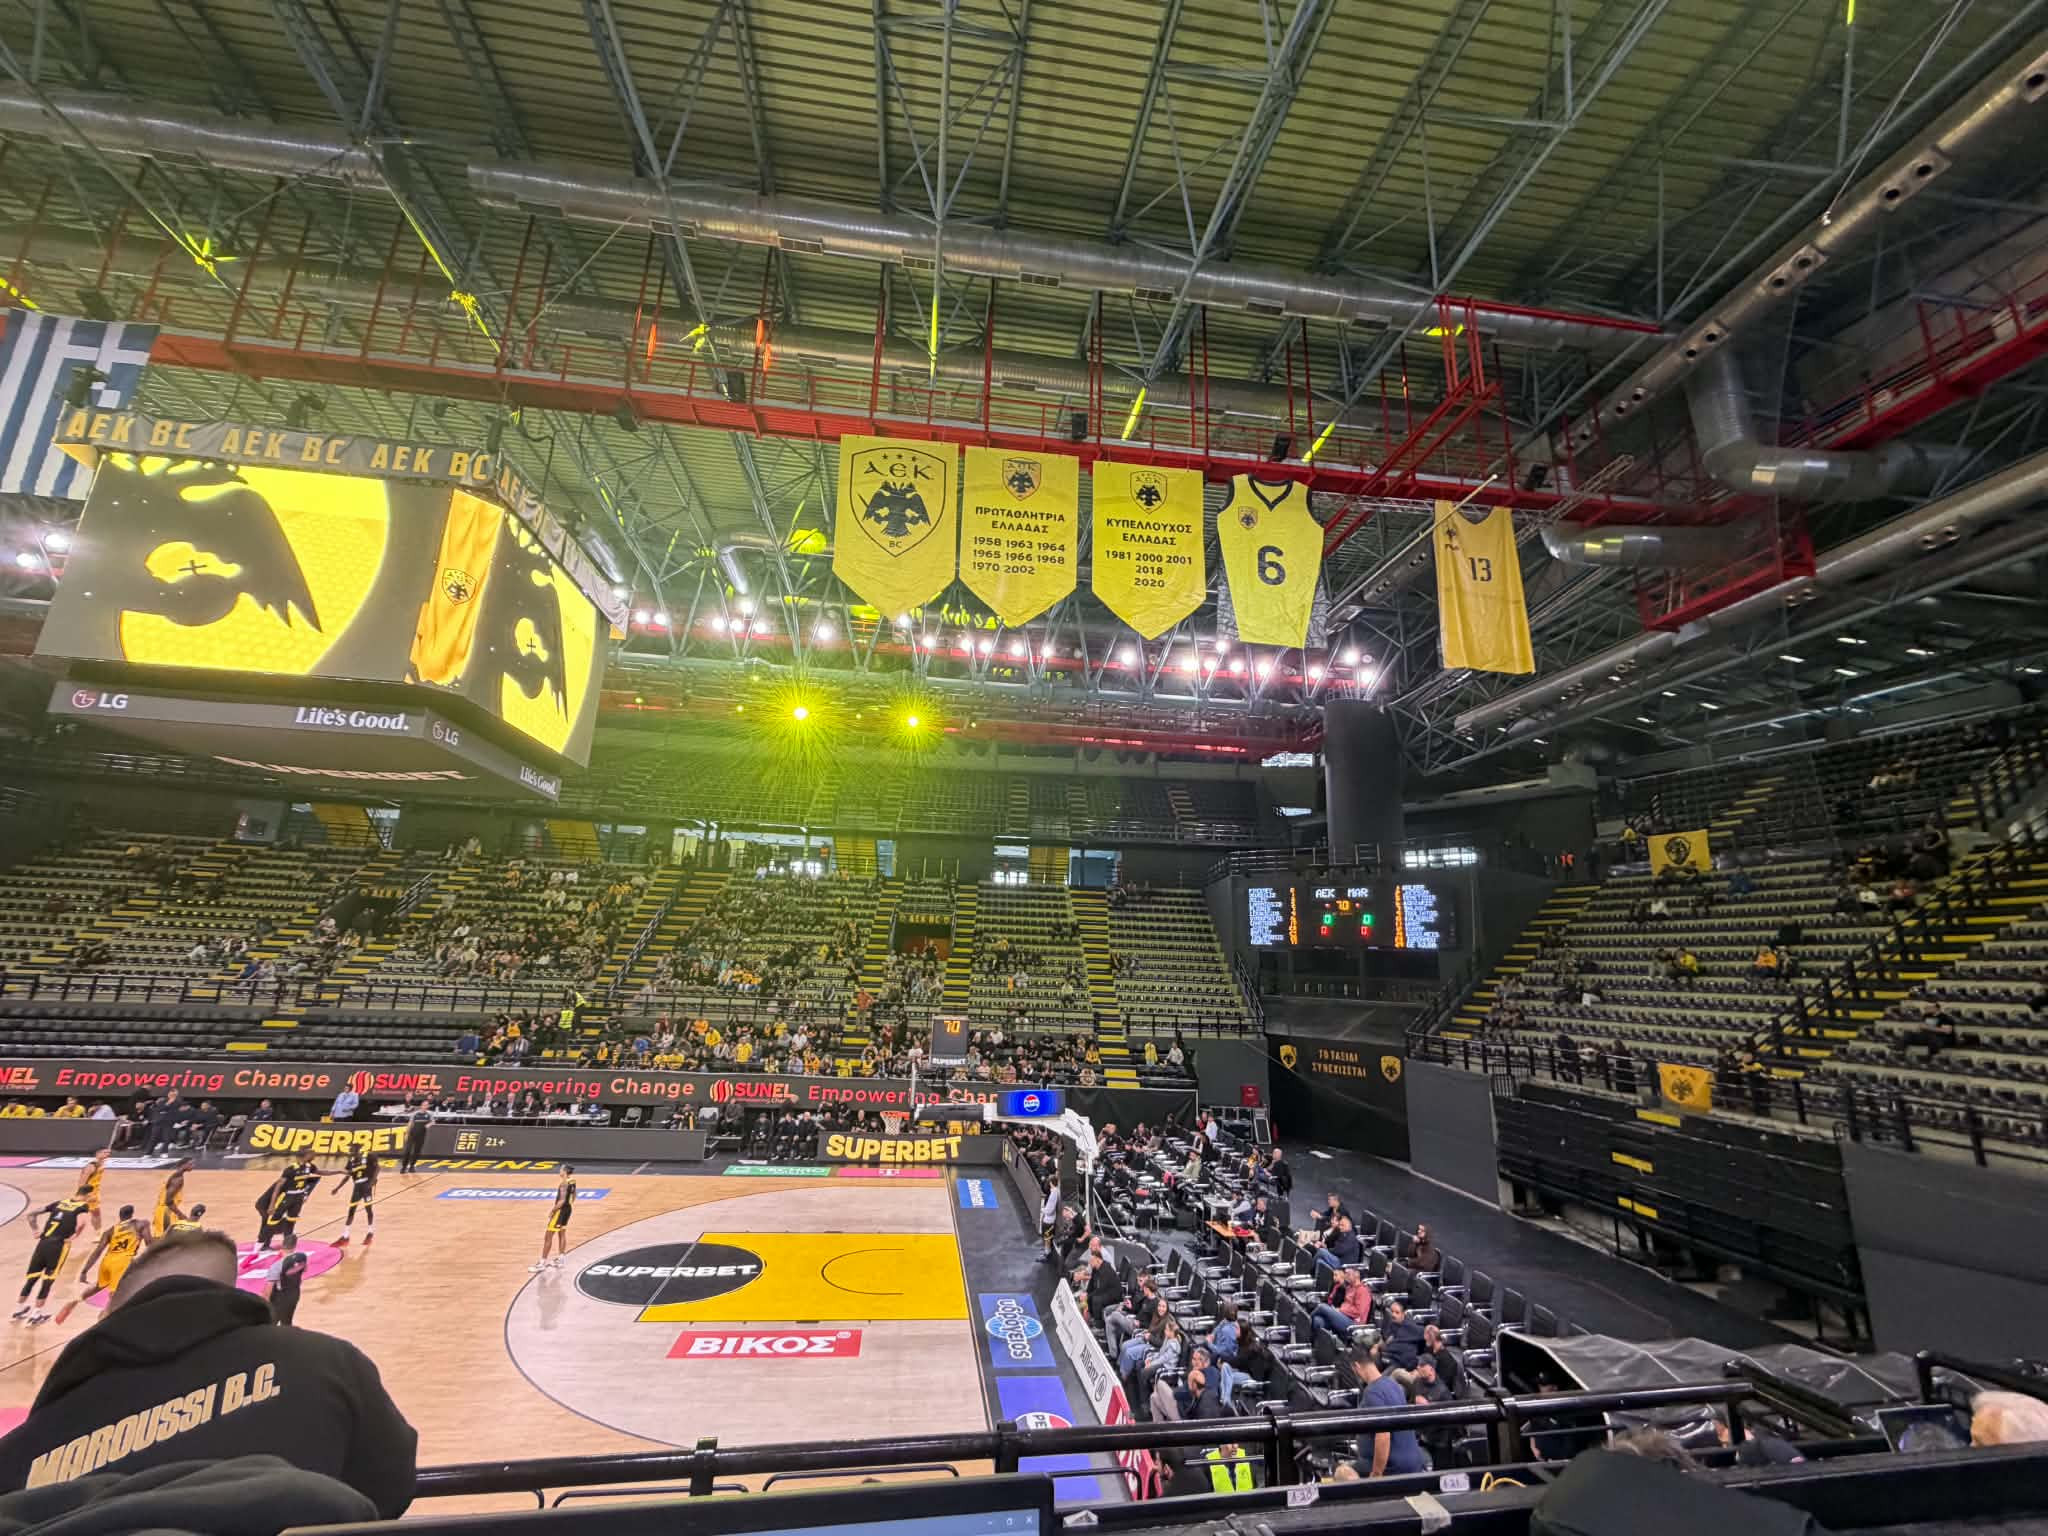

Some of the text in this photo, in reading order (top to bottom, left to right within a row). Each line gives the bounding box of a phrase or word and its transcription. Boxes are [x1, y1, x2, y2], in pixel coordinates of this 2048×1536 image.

[65, 411, 490, 480] AEK BC AEK BC AEK BC
[975, 506, 1065, 522] ΠΡΩΤΑΘΛΗΤΡΙΑ
[991, 520, 1049, 534] ΕΛΛΑΔΑΣ
[1106, 518, 1192, 534] ΚΥΠΕΛΛΟΥΧΟΣ
[974, 536, 1065, 552] 1958 1963 1964
[1122, 533, 1176, 546] ΕΛΛΑΔΑΣ
[974, 549, 1065, 565] 1965 1966 1968
[1105, 550, 1192, 565] 1981 2000 2001
[973, 561, 1035, 575] 1970 2002
[1135, 565, 1163, 575] 2018
[1258, 545, 1286, 586] 6
[1469, 556, 1492, 582] 13
[1134, 577, 1165, 588] 2020
[97, 693, 129, 709] LG
[295, 706, 410, 731] Life's Good.
[444, 727, 460, 746] LG
[1315, 888, 1369, 899] AEK MAR
[56, 1068, 224, 1091] Empowering
[234, 1069, 331, 1091] Change
[374, 1073, 442, 1090] SUNEL
[610, 1077, 696, 1098] Change
[734, 1082, 797, 1099] SUNEL
[250, 1123, 408, 1154] SUPERBET
[485, 1137, 507, 1147] 21+
[826, 1134, 961, 1161] SUPERBET
[447, 1188, 598, 1200] Stoiximn
[45, 1222, 60, 1237] 7
[585, 1264, 759, 1278] SUPERBET
[687, 1335, 836, 1355] ΒΙΚΟΣ
[1080, 1343, 1100, 1385] Allianz
[25, 1363, 280, 1491] MAROUSSI B.C.
